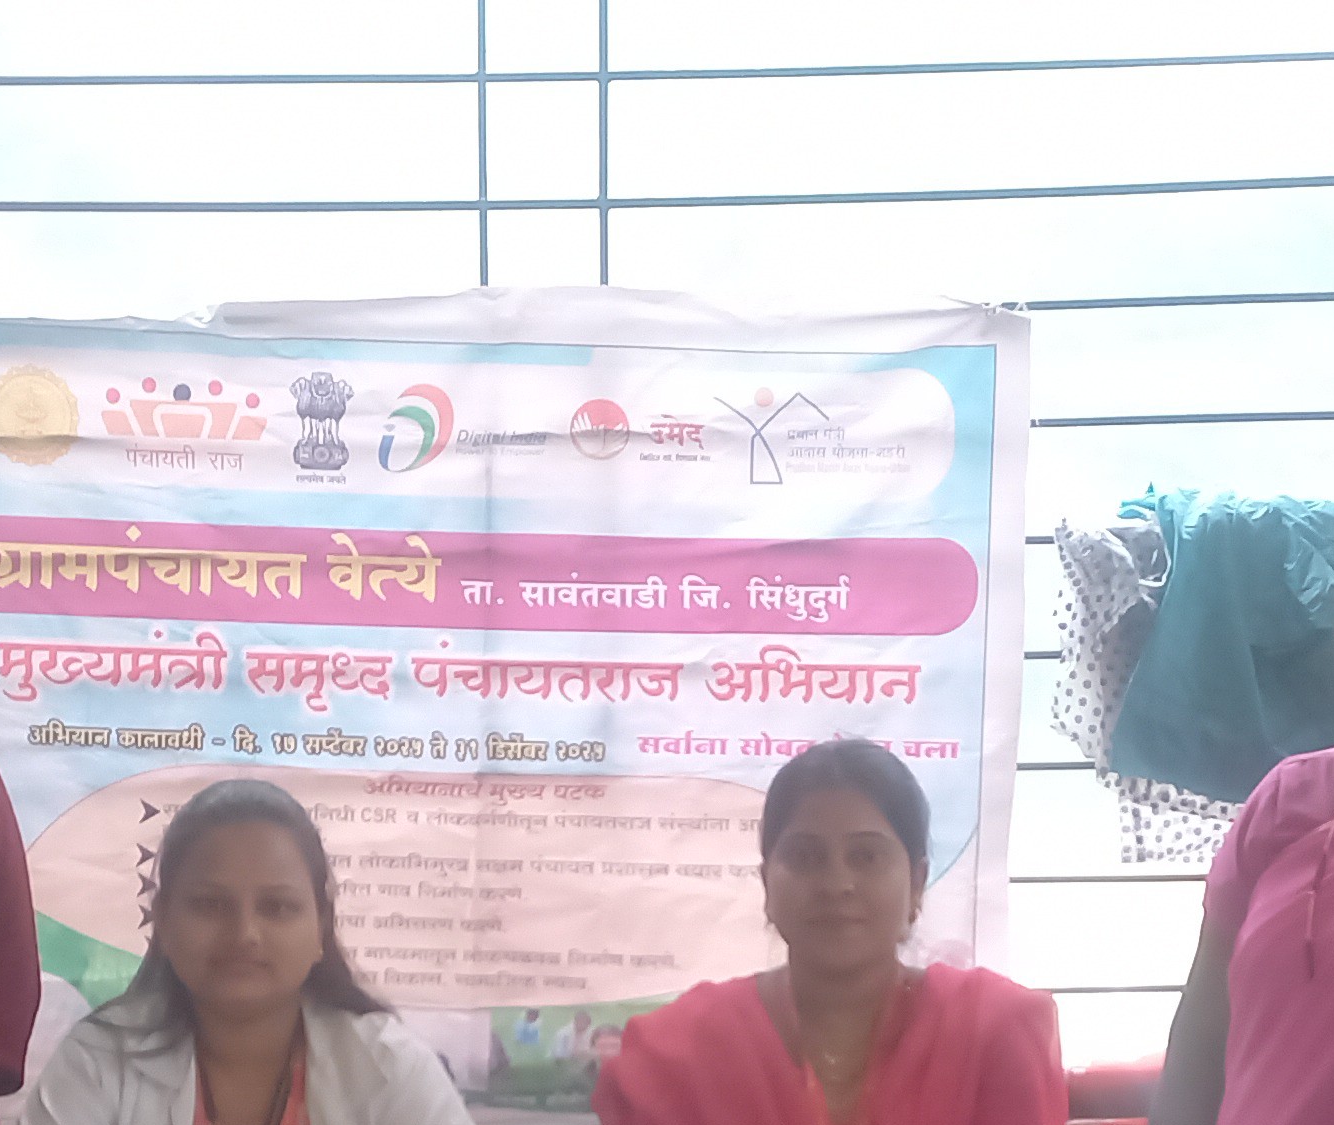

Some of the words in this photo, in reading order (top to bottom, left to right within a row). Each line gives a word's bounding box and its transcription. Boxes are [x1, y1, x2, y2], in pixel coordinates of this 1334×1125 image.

[457, 429, 507, 448] Digital
[126, 443, 196, 470] पंचायती
[208, 451, 244, 472] राज
[326, 532, 442, 603] वेत्ये
[460, 577, 504, 606] ता.
[519, 571, 667, 610] सावंतवाडी
[678, 574, 731, 610] जि.
[747, 574, 851, 623] सिंधुदुर्ग
[410, 640, 685, 703] पंचायतराज
[705, 644, 922, 705] अभियान
[28, 718, 112, 748] अभियान
[116, 722, 206, 750] कालावधी
[233, 723, 262, 754] दि.
[272, 733, 297, 755] १७
[430, 730, 448, 760] ते
[902, 740, 959, 759] चला
[489, 783, 544, 807] मुख्य
[554, 784, 607, 800] घटक
[360, 806, 397, 824] CSR
